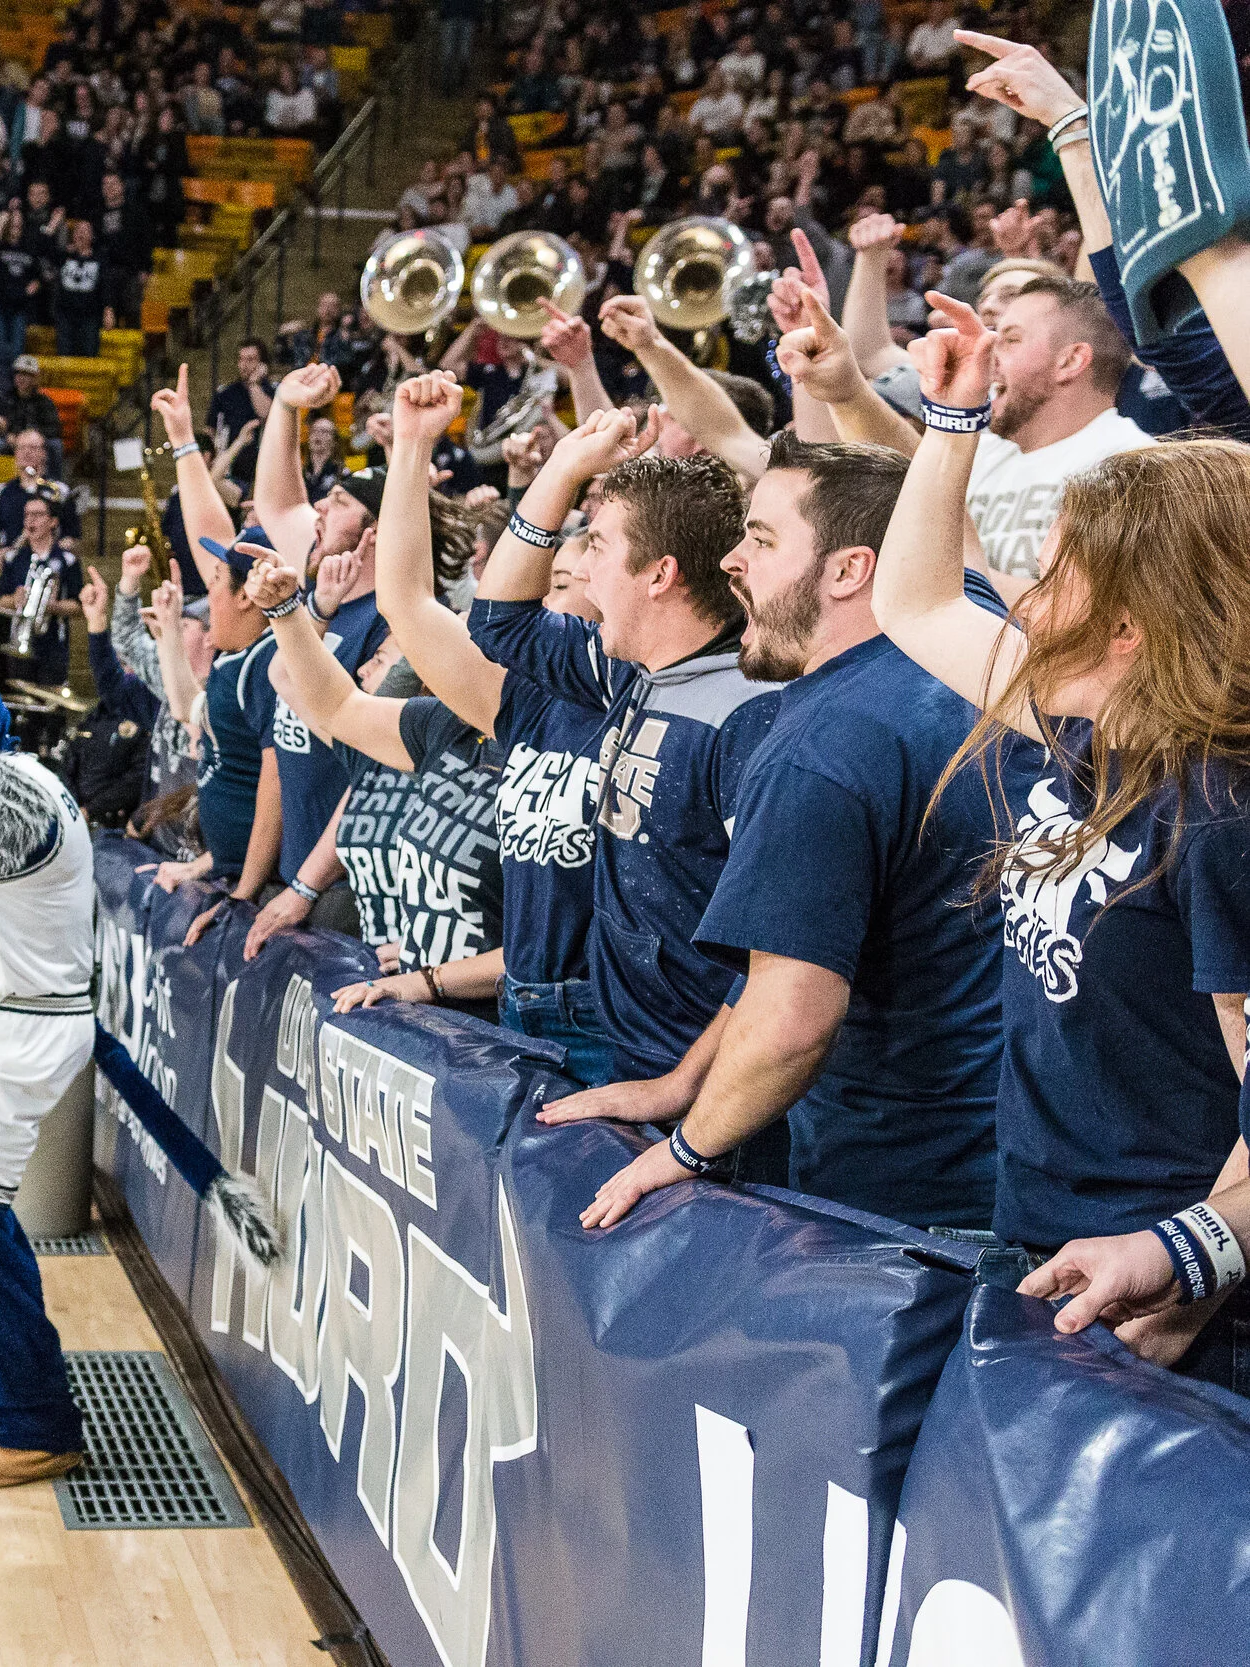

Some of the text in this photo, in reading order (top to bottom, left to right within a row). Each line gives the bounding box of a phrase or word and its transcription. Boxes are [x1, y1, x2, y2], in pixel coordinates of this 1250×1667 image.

[920, 403, 984, 432] HURD
[512, 517, 555, 547] HURD
[318, 1020, 438, 1211] STATE
[1188, 1205, 1230, 1252] HURD
[1171, 1234, 1196, 1263] HURD
[211, 977, 537, 1667] HURD
